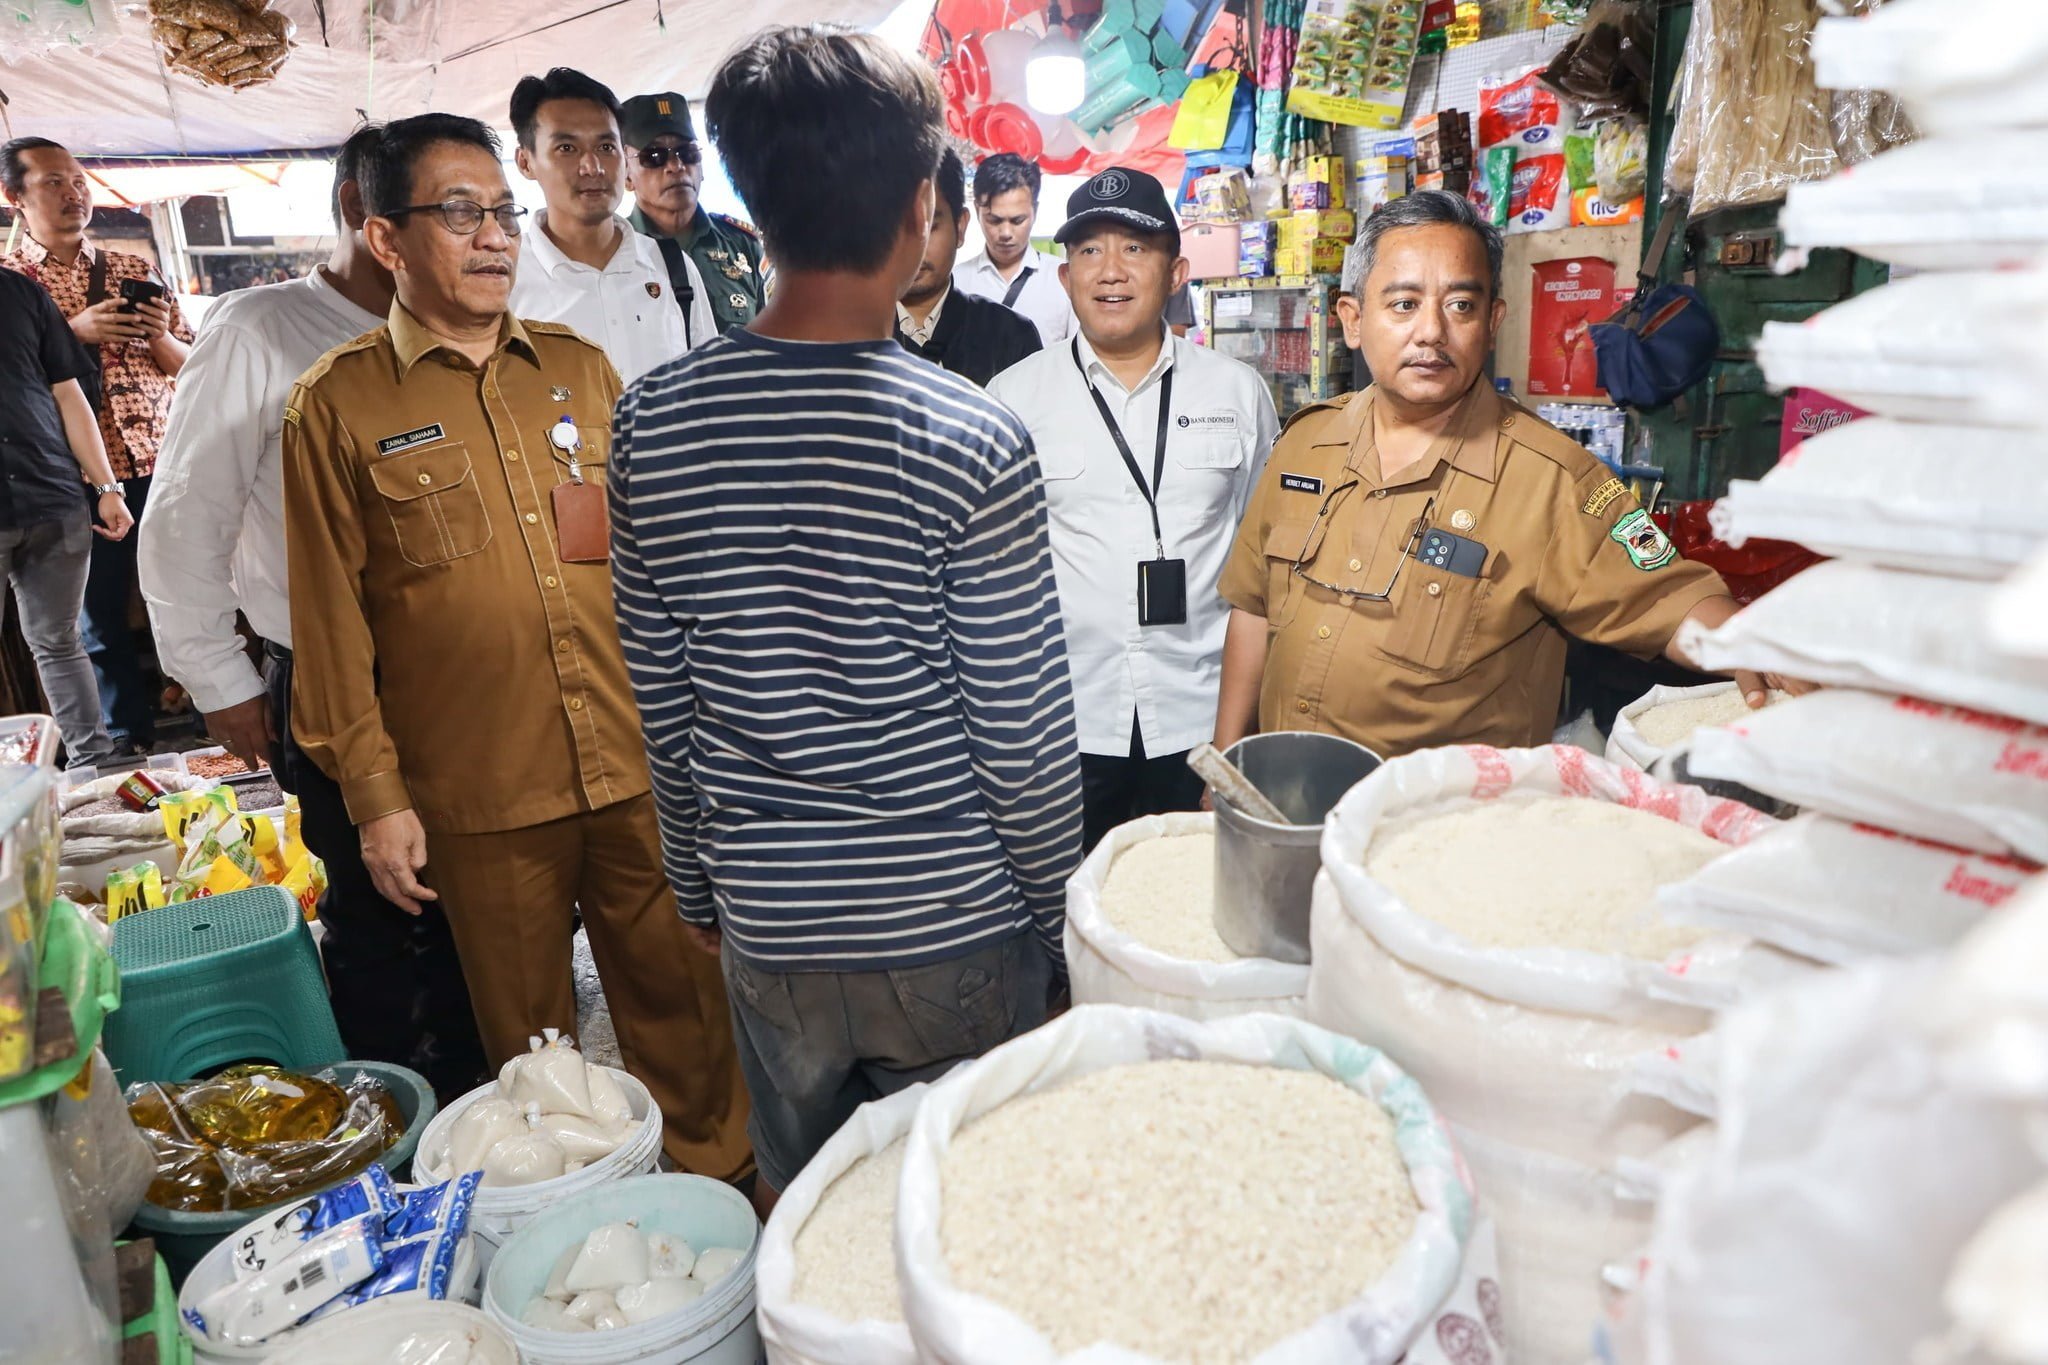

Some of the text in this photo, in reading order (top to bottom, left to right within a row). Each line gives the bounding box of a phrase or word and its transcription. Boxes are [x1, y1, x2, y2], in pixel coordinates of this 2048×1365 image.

[1207, 416, 1235, 424] INDONESIA
[1799, 407, 1852, 433] Soffell
[385, 428, 437, 449] ZAINAL SIAHAAN
